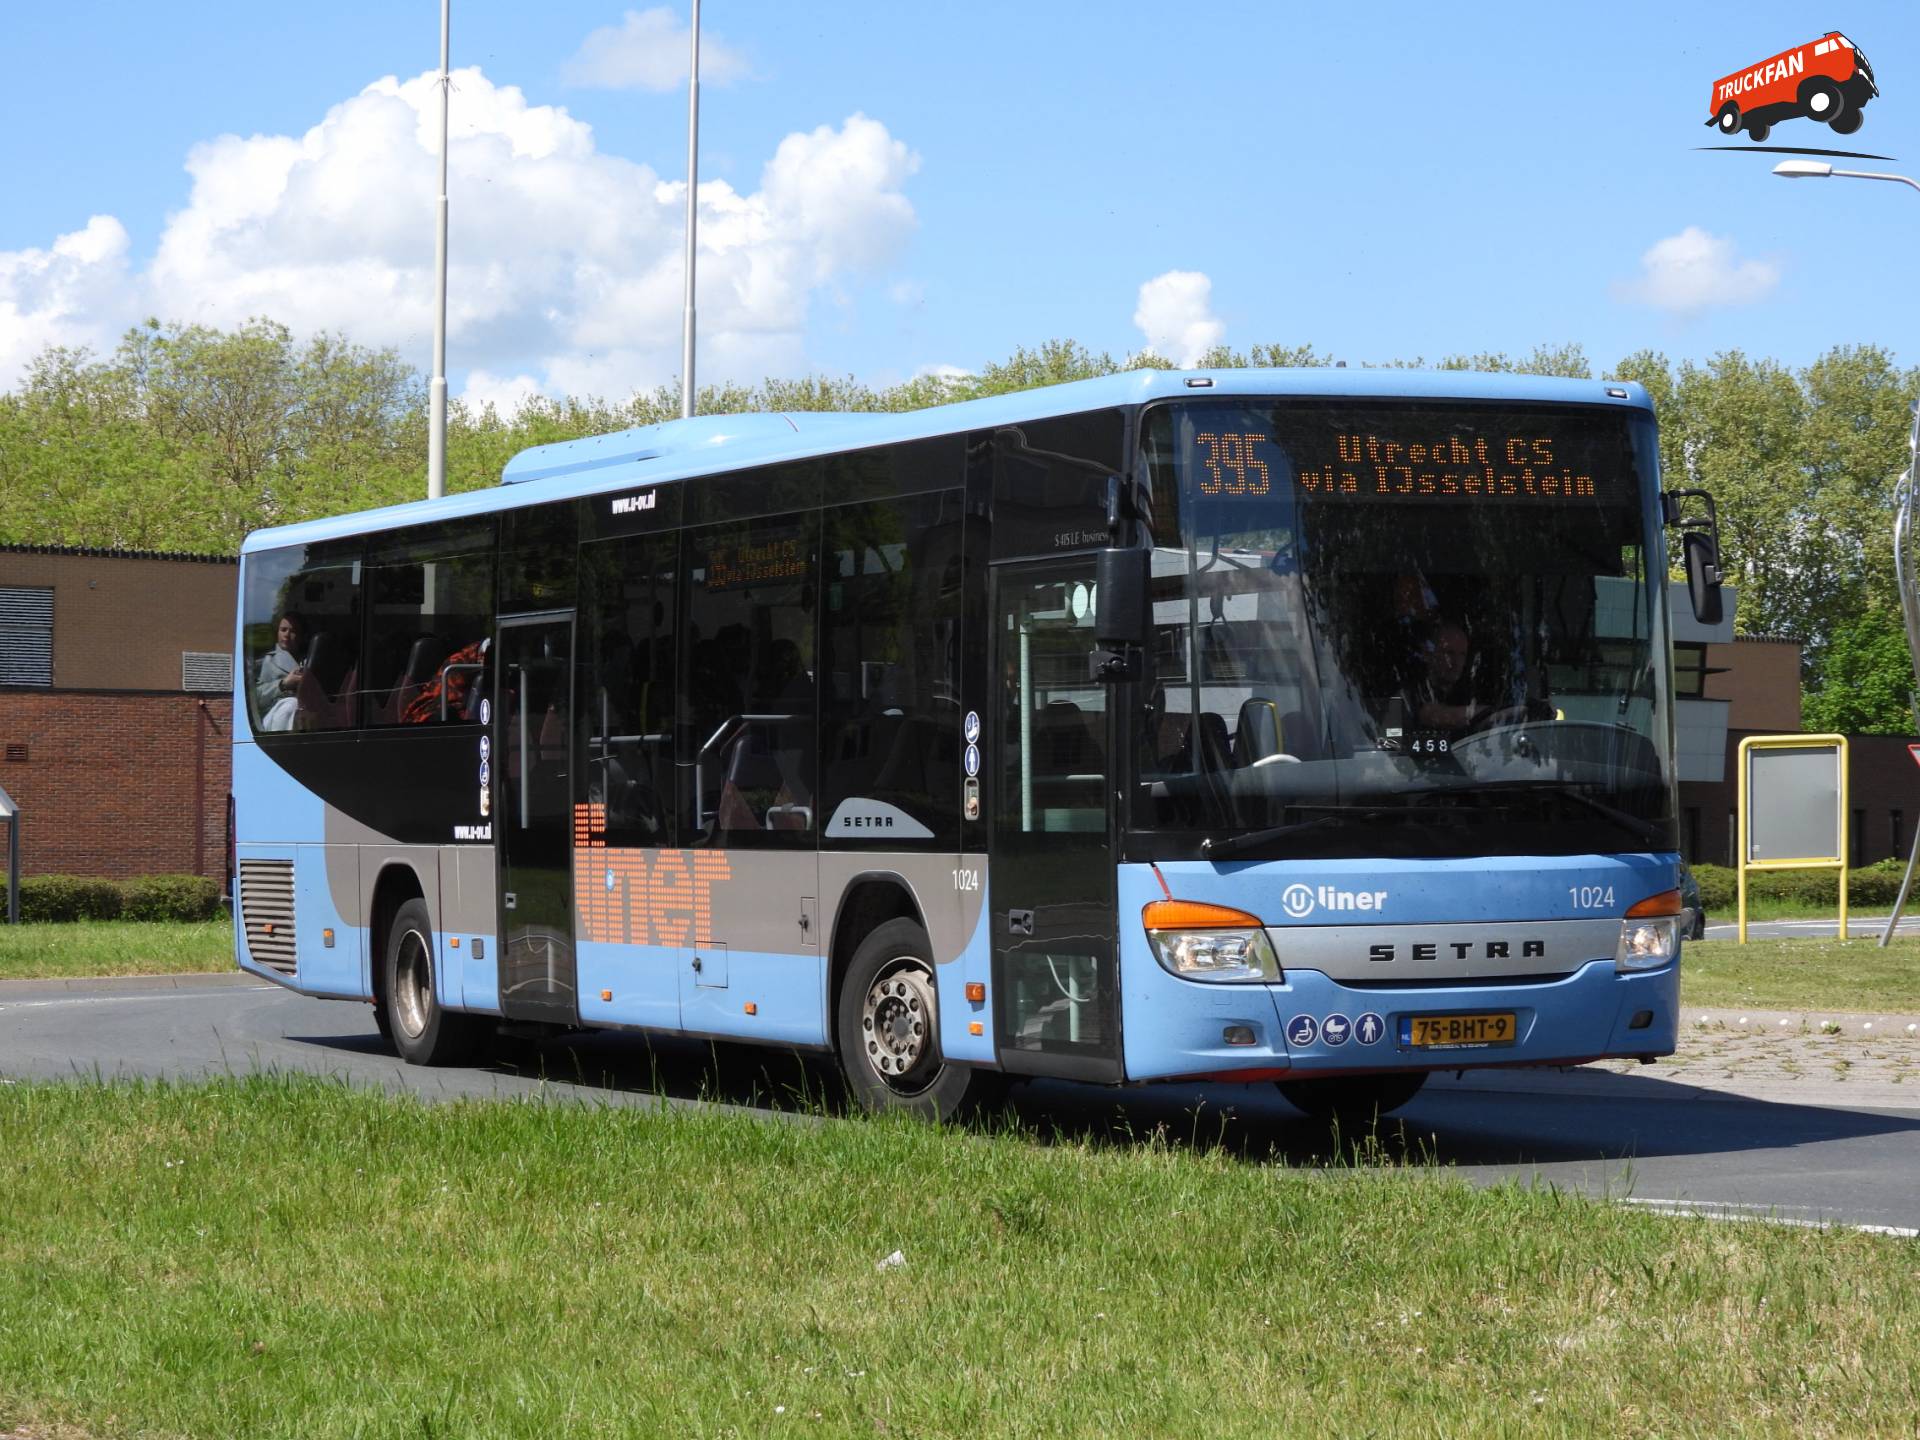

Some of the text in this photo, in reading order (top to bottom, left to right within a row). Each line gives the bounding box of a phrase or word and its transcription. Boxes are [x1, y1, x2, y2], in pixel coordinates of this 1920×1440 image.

[1197, 432, 1553, 495] 395 Utrecht CS
[1301, 464, 1595, 496] via IJsselstein
[844, 816, 893, 827] SETRA
[952, 870, 979, 890] 1024
[1569, 886, 1616, 909] 1024
[1369, 940, 1545, 962] SETRA
[1418, 1018, 1507, 1041] 75-BHT-9
